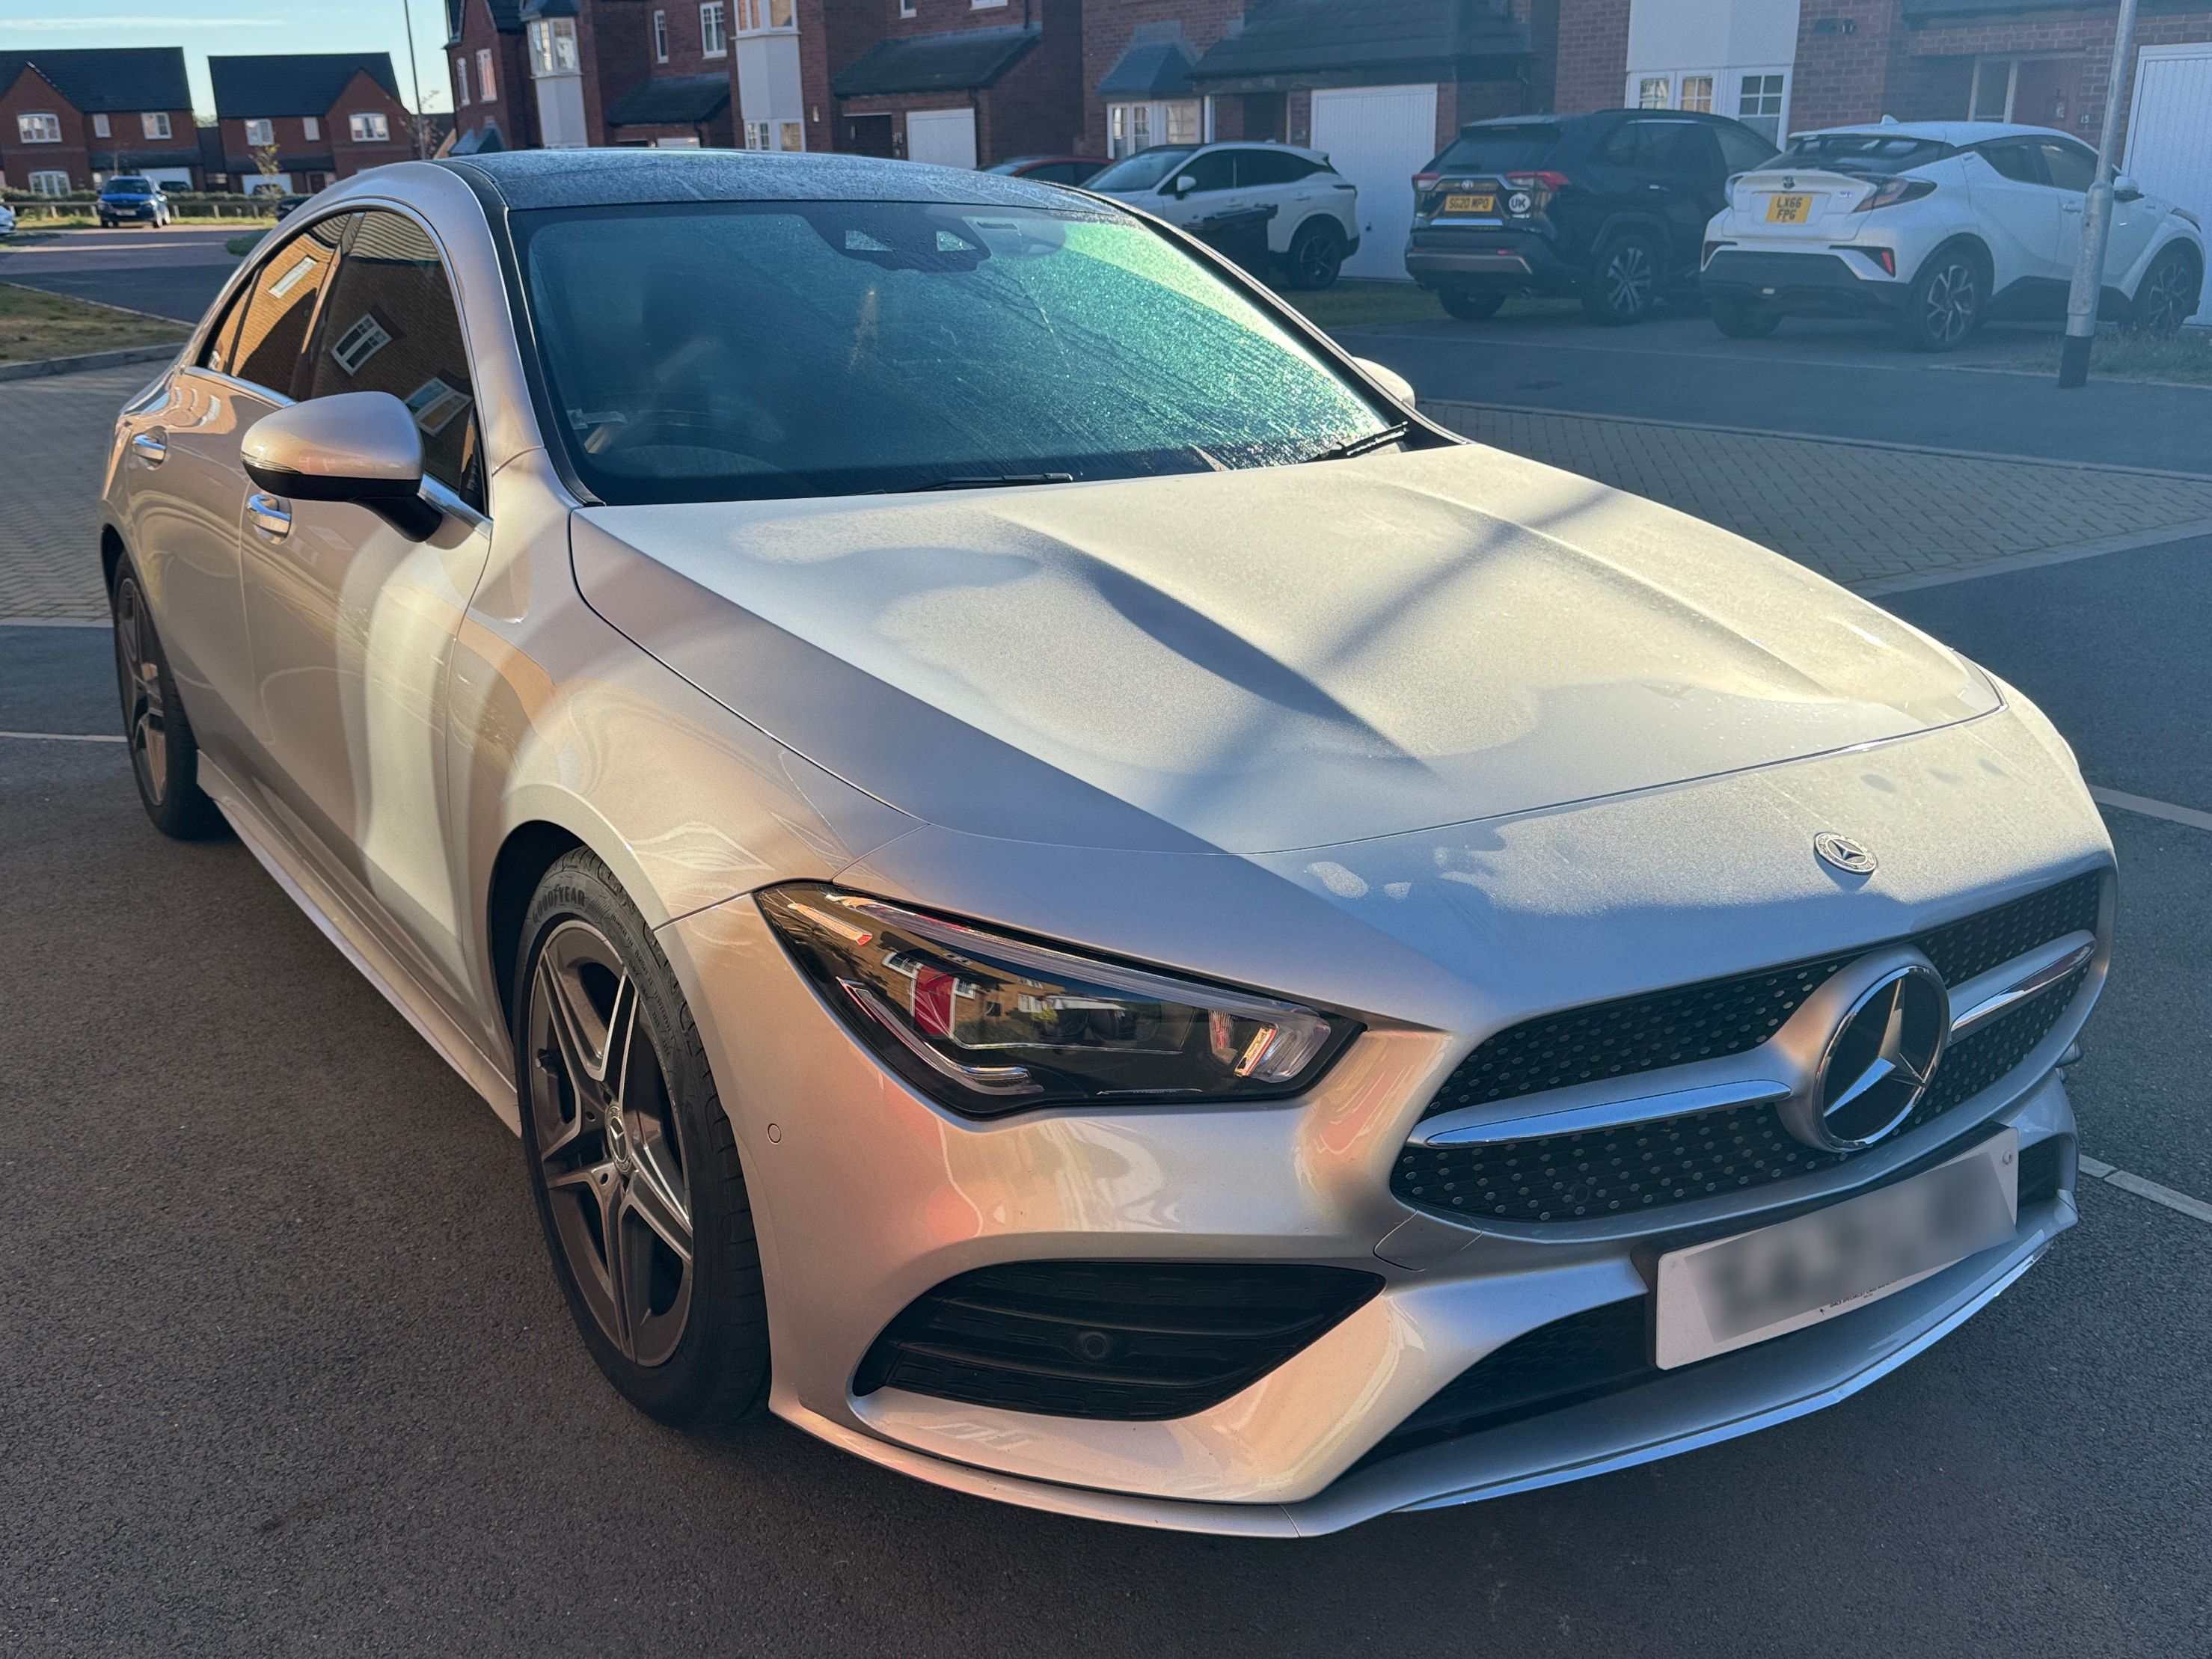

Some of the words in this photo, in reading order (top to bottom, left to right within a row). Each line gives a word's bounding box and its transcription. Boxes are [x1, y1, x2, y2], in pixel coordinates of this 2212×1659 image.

[1511, 198, 1526, 209] UK
[1776, 197, 1803, 209] LX66
[532, 884, 586, 924] GOODYEAR
